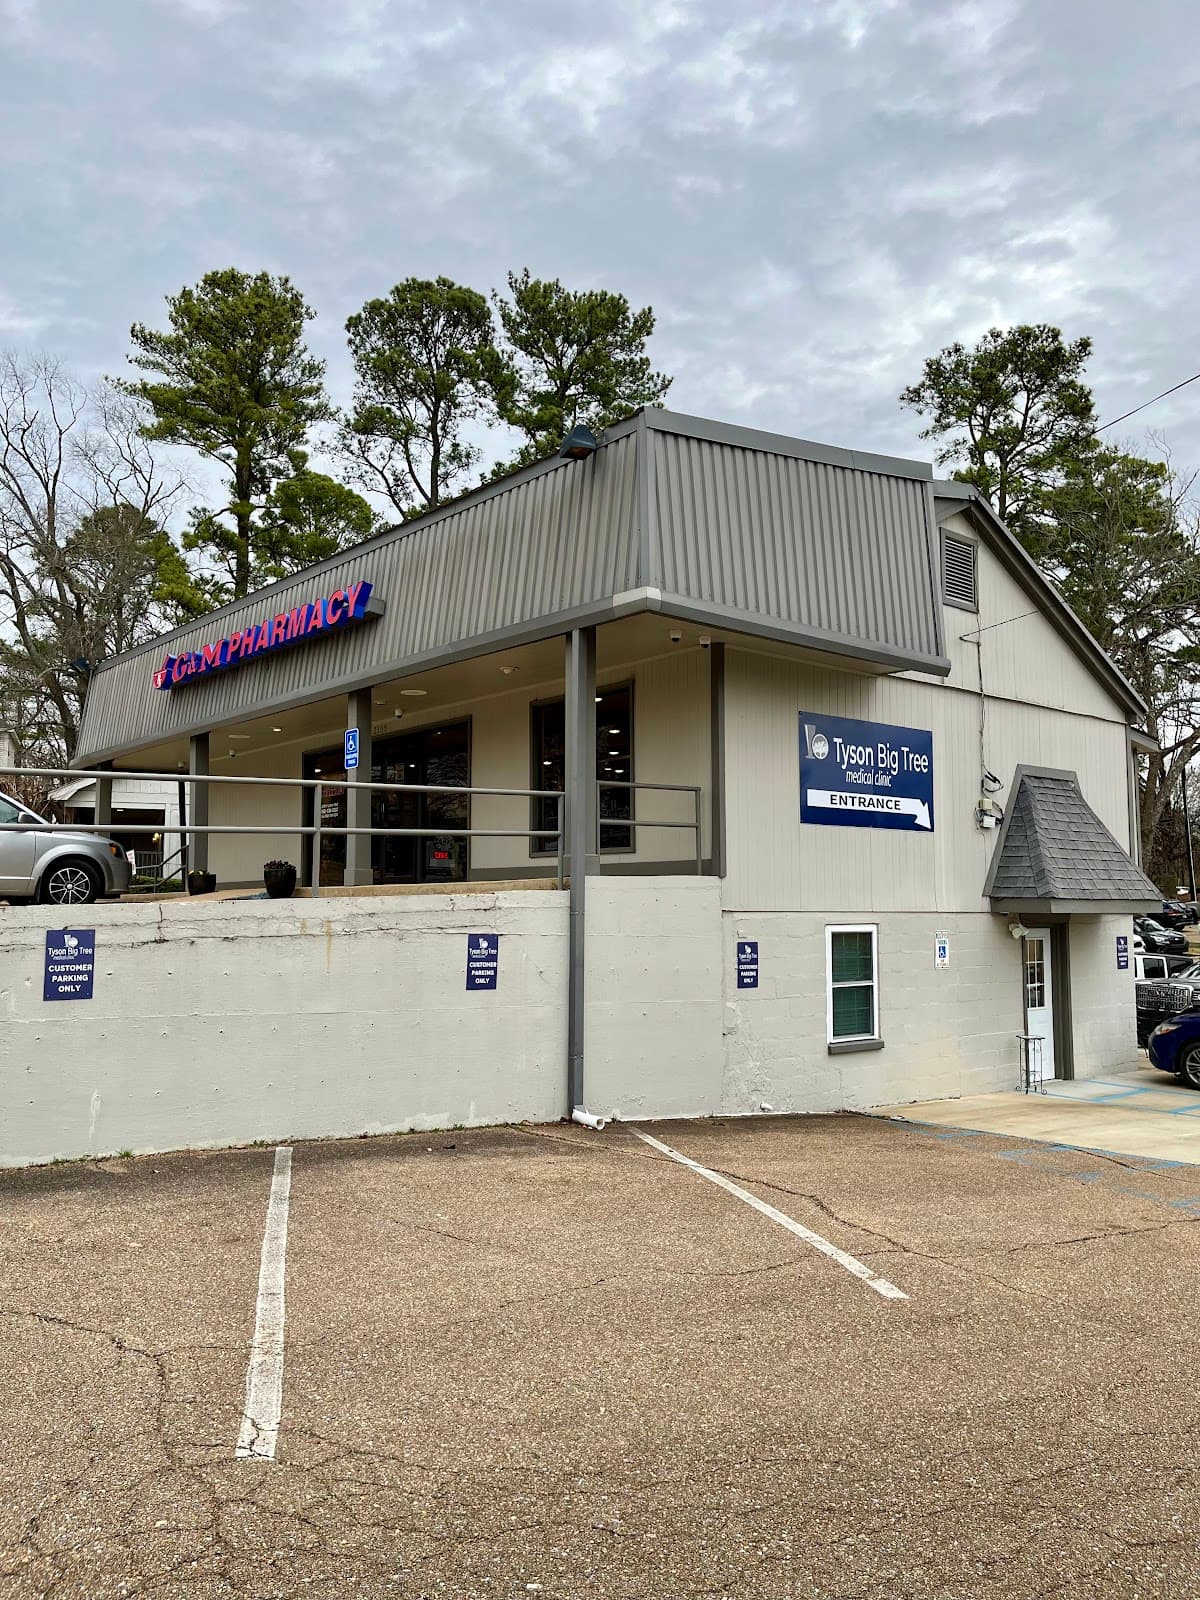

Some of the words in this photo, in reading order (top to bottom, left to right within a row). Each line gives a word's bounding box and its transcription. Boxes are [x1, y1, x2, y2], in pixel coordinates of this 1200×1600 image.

[226, 580, 373, 662] PHARMACY
[833, 737, 875, 770] Tyson
[877, 743, 899, 776] Big
[901, 746, 929, 773] Tree
[845, 768, 874, 786] medical
[874, 770, 892, 788] clinic
[830, 794, 901, 811] ENTRANCE
[48, 947, 67, 958] Tyson
[68, 947, 79, 957] Big
[79, 946, 93, 955] Tree
[48, 964, 93, 972] CUSTOMER
[51, 974, 89, 983] PARKING
[58, 984, 82, 993] ONLY
